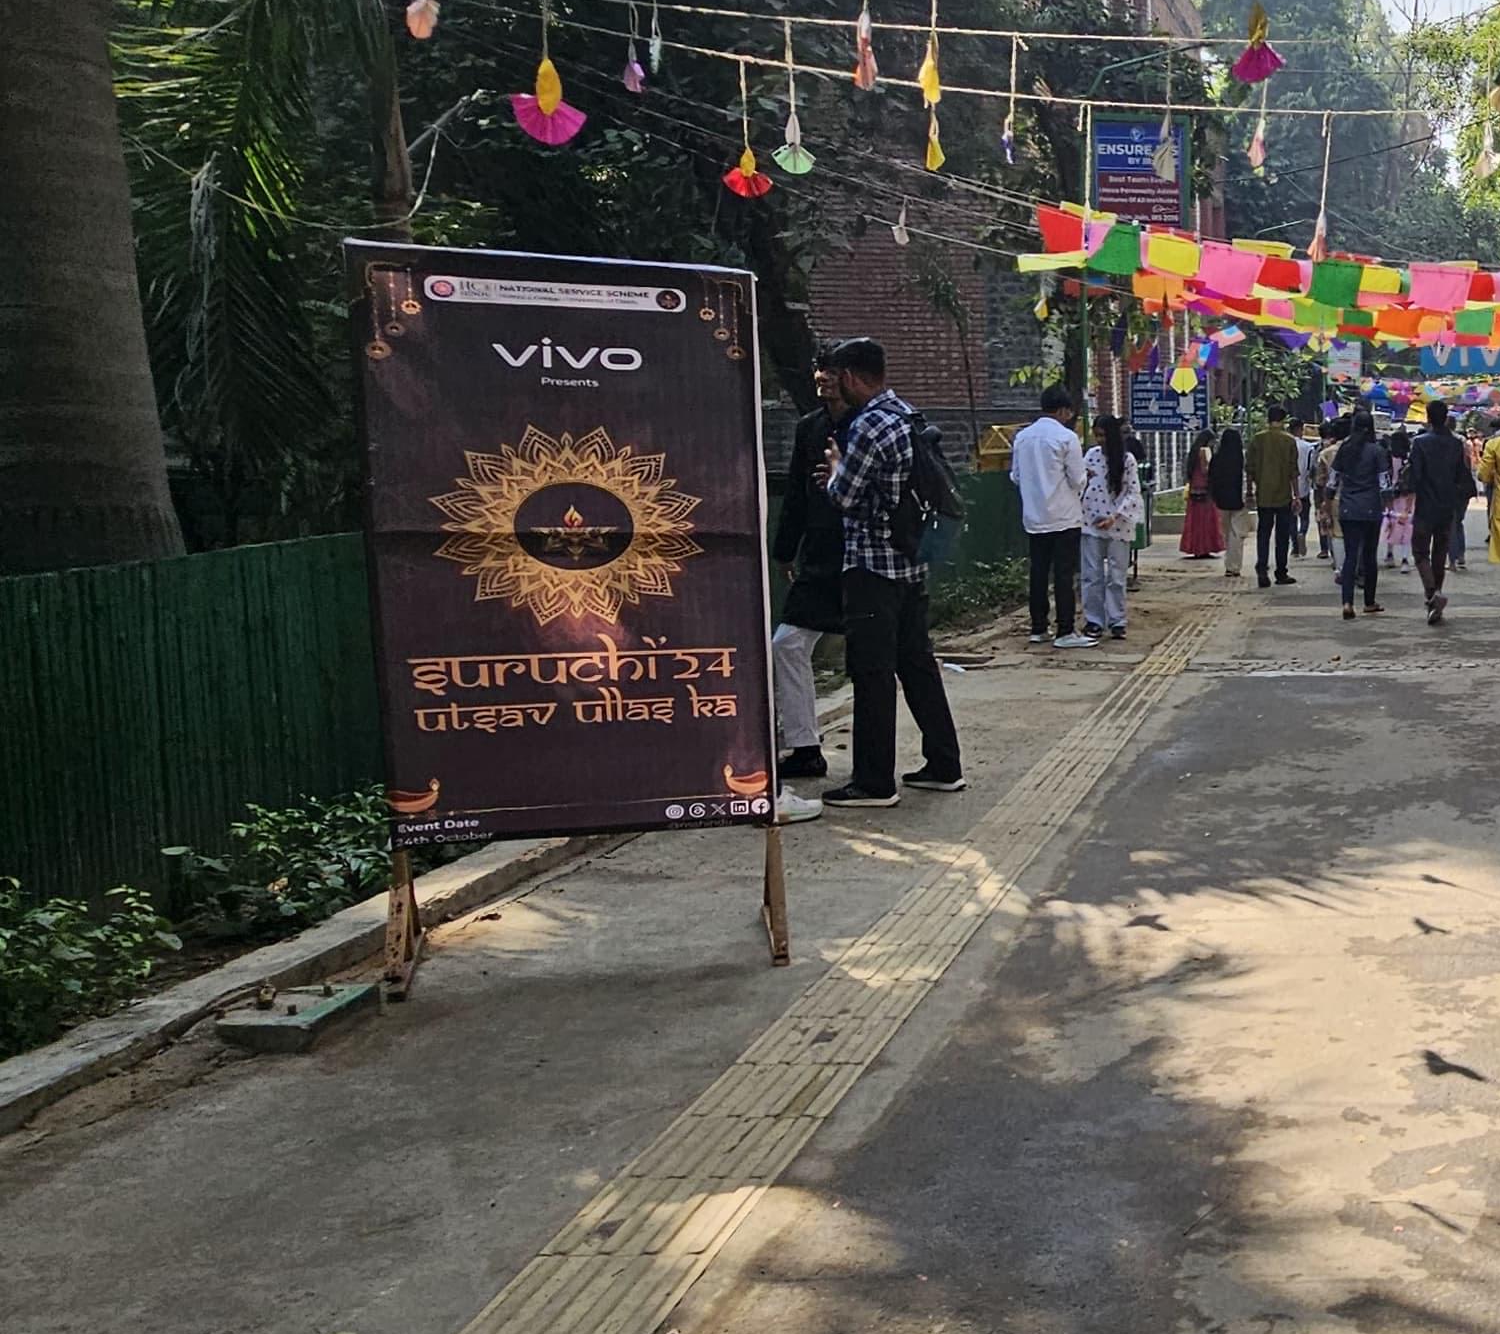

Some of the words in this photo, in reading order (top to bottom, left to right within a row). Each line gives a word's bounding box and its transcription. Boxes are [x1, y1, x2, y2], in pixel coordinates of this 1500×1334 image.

[1098, 144, 1153, 155] ENSURE
[500, 284, 556, 294] NATIONAL
[559, 288, 602, 297] SERVICE
[606, 290, 649, 298] SCHEME
[492, 337, 643, 371] vivo
[541, 376, 599, 388] Presents
[397, 820, 441, 834] Event
[444, 818, 480, 830] Date
[434, 830, 494, 843] October
